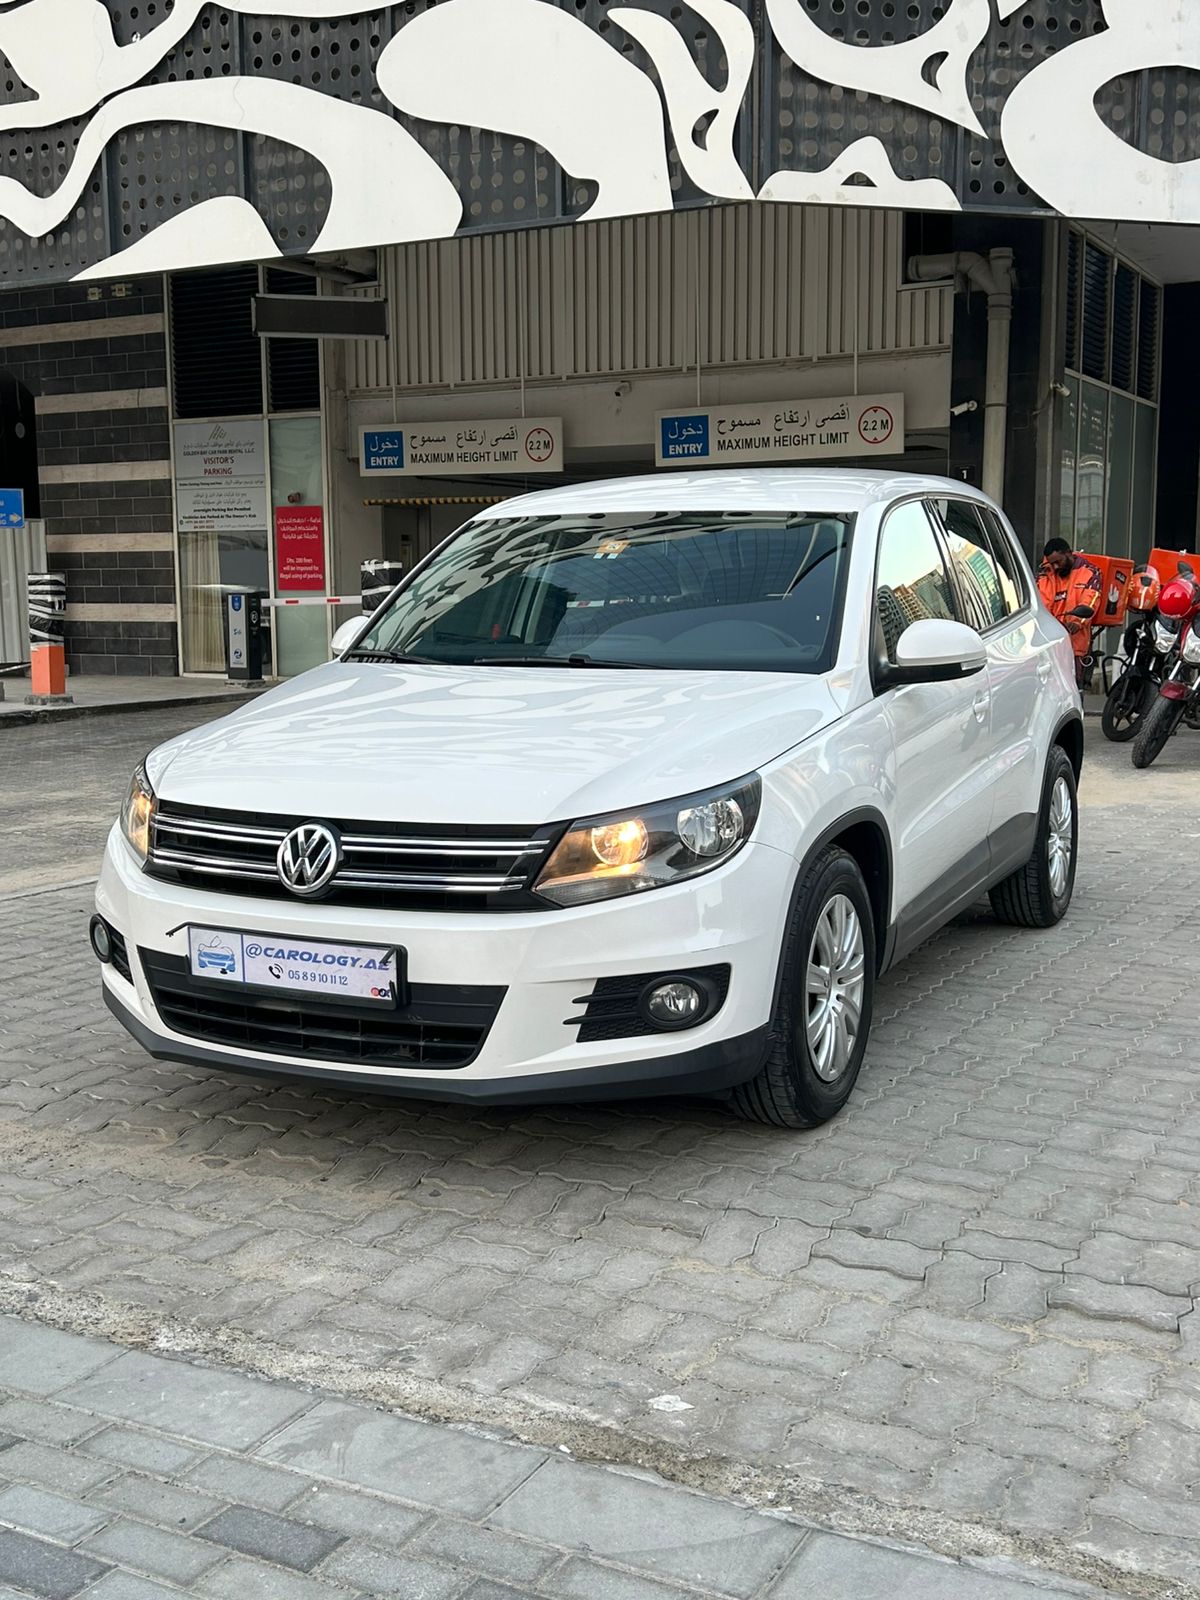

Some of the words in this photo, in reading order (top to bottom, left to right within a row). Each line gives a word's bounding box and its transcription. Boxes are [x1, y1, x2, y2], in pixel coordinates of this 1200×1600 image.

[716, 418, 761, 435] مسموح
[773, 410, 811, 431] ارتفاع
[862, 420, 878, 431] 2.2
[880, 419, 889, 430] M
[668, 421, 704, 440] دخول
[370, 435, 399, 453] دخول
[409, 434, 446, 449] مسموح
[456, 429, 487, 449] ارتفاع
[528, 440, 541, 451] 2.2
[543, 440, 551, 450] M
[717, 436, 770, 451] MAXIMUM
[773, 433, 816, 447] HEIGHT
[819, 431, 850, 445] LIMIT
[668, 443, 703, 455] ENTRY
[203, 456, 235, 465] VISITOR'S
[370, 456, 399, 466] ENTRY
[410, 452, 454, 464] MAXIMUM
[456, 451, 491, 463] HEIGHT
[493, 450, 519, 462] LIMIT
[203, 467, 233, 475] PARKING
[962, 470, 967, 479] 1
